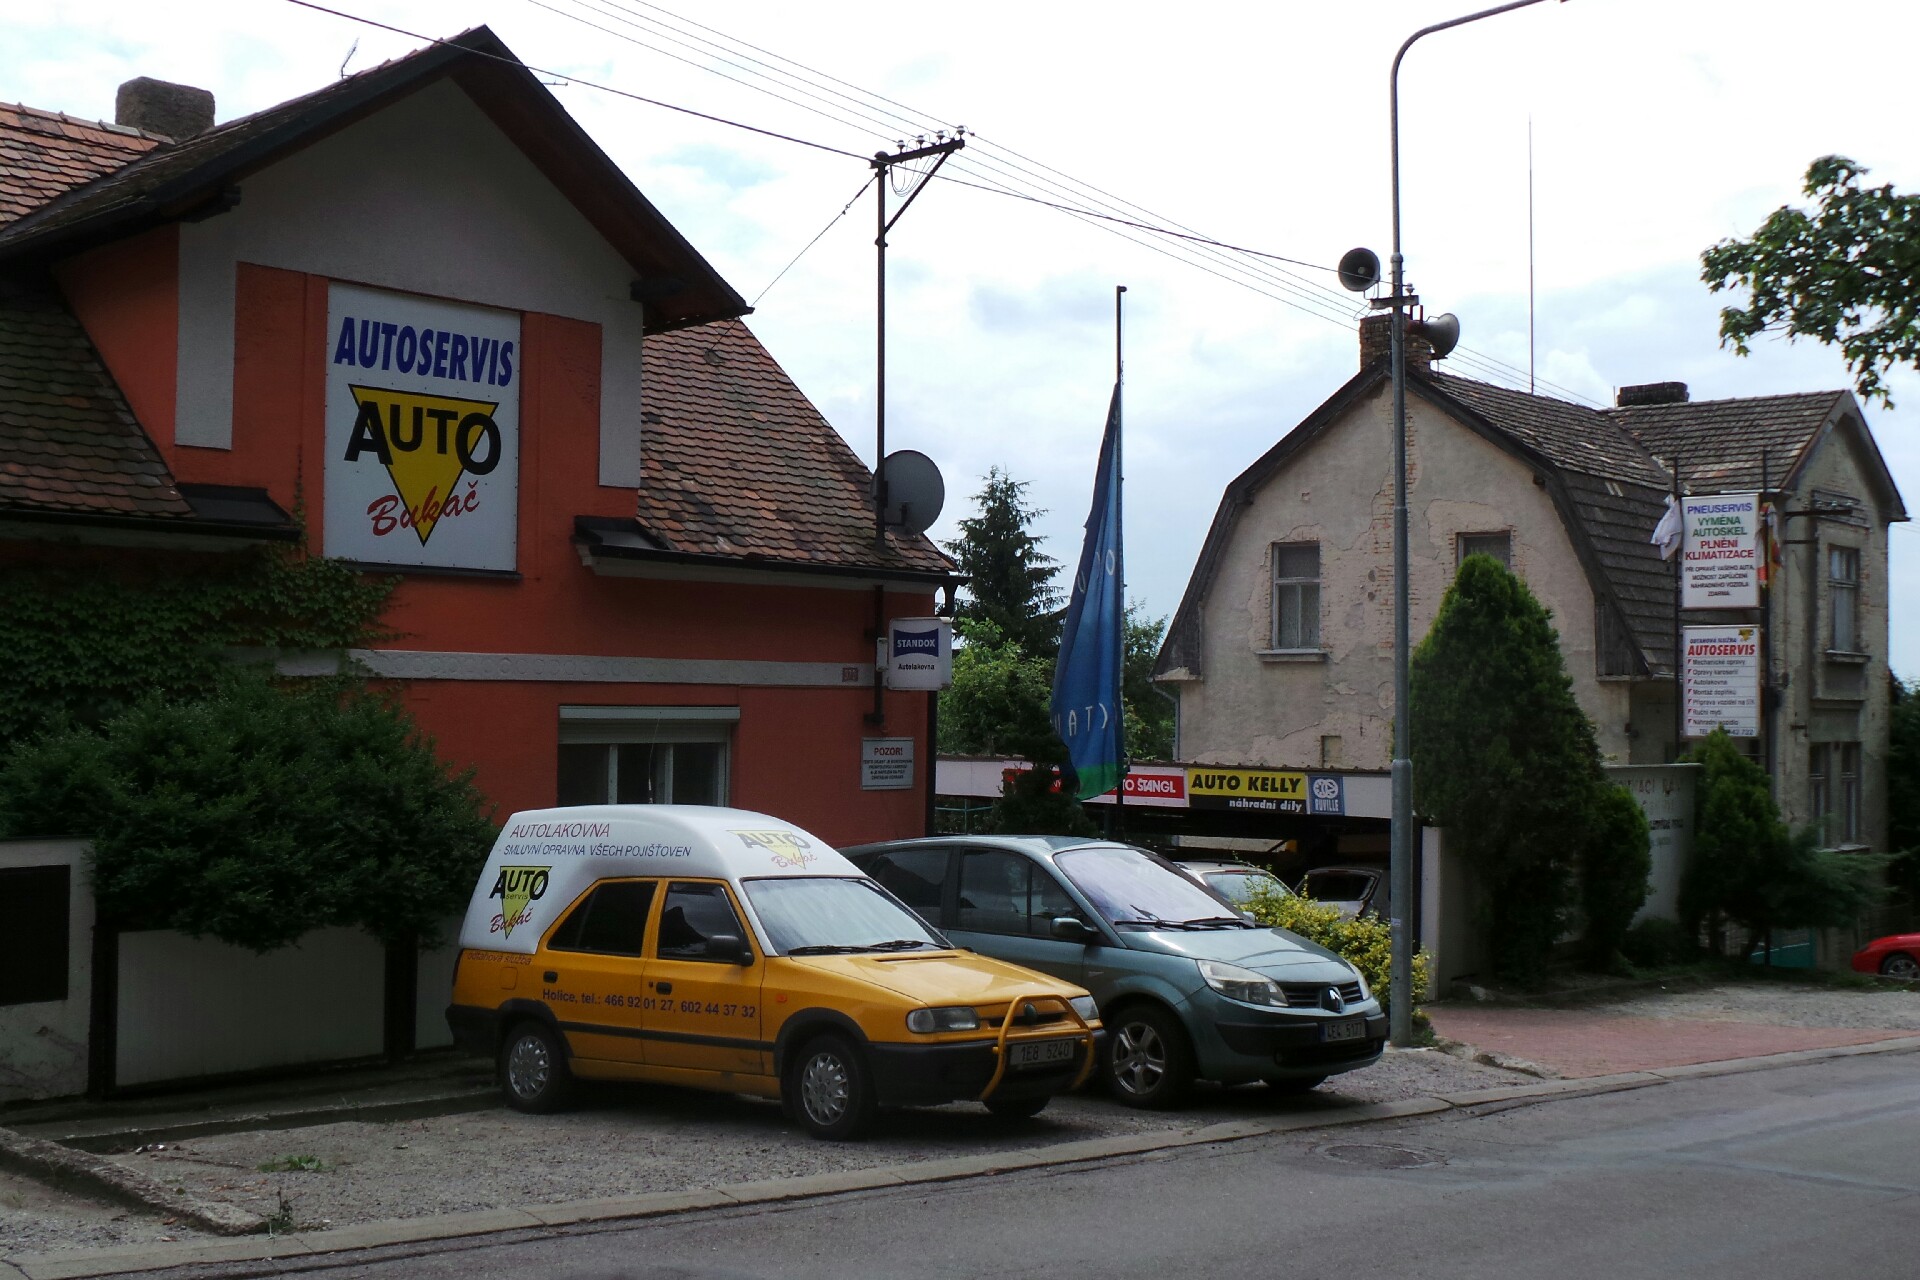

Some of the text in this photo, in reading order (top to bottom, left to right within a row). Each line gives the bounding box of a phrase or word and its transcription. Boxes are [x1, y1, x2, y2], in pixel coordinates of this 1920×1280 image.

[334, 317, 514, 387] AUTOSERVIS
[344, 401, 502, 475] AUTO
[366, 480, 481, 537] Bukač
[1687, 503, 1753, 514] PNEUSERVIS
[1692, 527, 1748, 537] AUTOSKEL
[1700, 537, 1739, 549] PLNĚNÍ
[1685, 550, 1755, 560] KLIMATIZACE
[896, 639, 936, 648] STANDOX
[1687, 644, 1756, 655] AUTOSERVIS
[873, 746, 903, 756] POZOR!
[1137, 777, 1176, 793] ŠTANGL
[1191, 774, 1302, 793] AUTO KELLY
[1229, 797, 1303, 813] náhradní díly
[509, 823, 610, 838] AUTOLAKOVNA
[737, 832, 811, 849] AUTO
[503, 842, 692, 857] SMLUVNÍ OPRAVNA VŠECH POJIŠŤOVEN
[489, 869, 549, 900] AUTO
[490, 907, 534, 933] Bukač
[543, 988, 756, 1018] Holice, tel.: 466 92 01 27, 602 44 37 32
